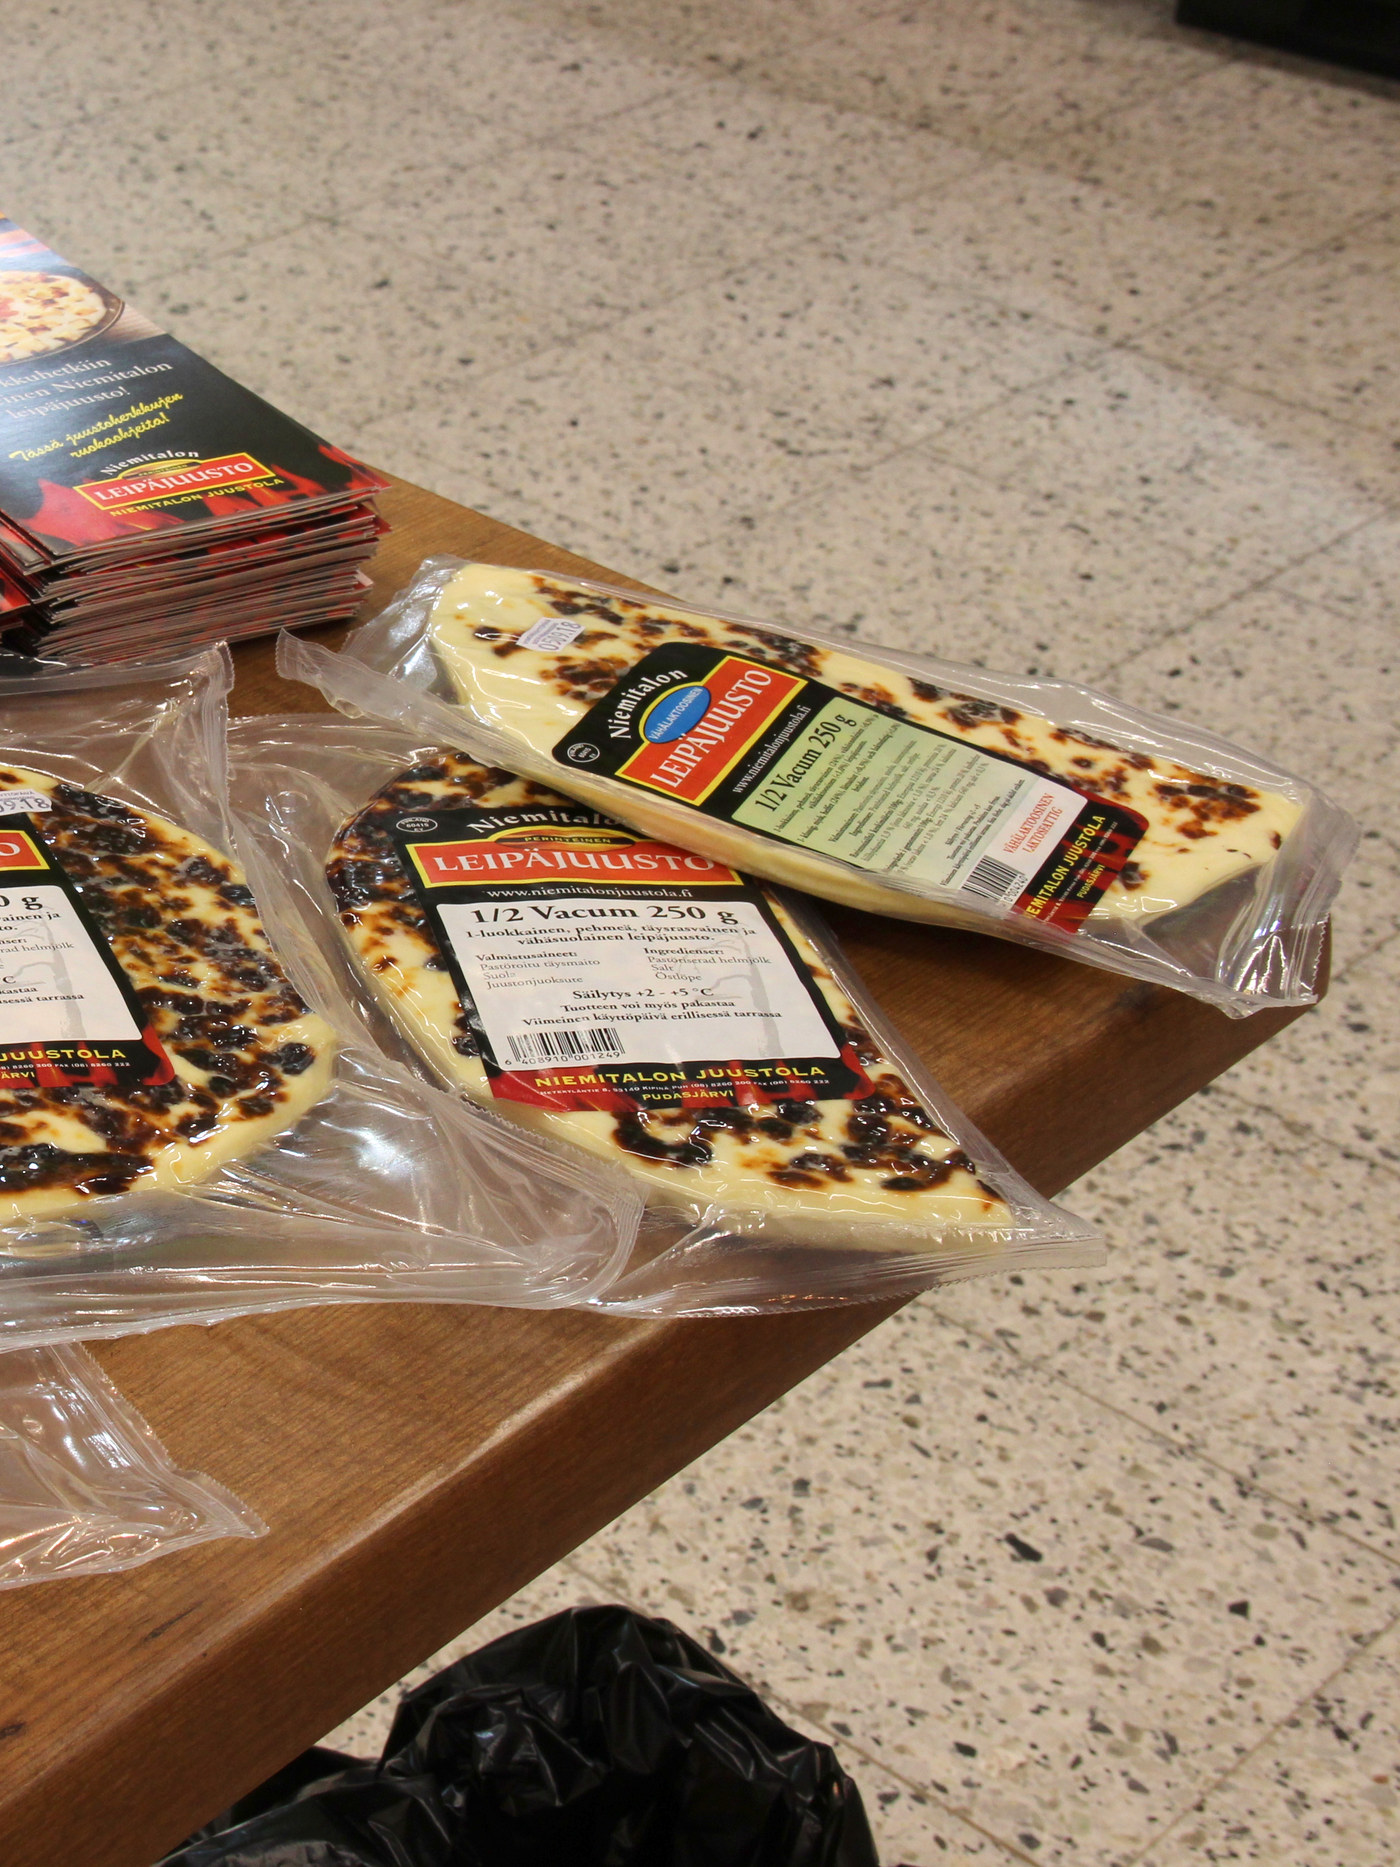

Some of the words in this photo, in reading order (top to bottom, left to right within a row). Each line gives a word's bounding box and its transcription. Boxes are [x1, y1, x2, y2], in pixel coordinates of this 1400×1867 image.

[51, 361, 173, 394] Niemitalon
[5, 386, 130, 420] leipäjuusto!
[8, 439, 64, 462] Tässä
[66, 392, 184, 446] juustoherkkujen
[70, 412, 170, 459] ruokaohjeita!
[100, 449, 200, 476] Niemitalon
[94, 461, 254, 501] LEIPÄJUUSTO
[109, 493, 203, 517] NIEMITALON
[206, 479, 285, 498] JUUSTOLA
[608, 668, 688, 741] Niemitalon
[650, 669, 772, 788] LEIPÄJUUSTO
[732, 705, 812, 794] www.niemitalonjuustola.fi
[755, 789, 787, 812] 1/2
[771, 748, 822, 789] Vacum
[808, 721, 842, 749] 250
[834, 714, 857, 727] g
[466, 810, 616, 834] Niemitalo
[524, 836, 611, 844] PERINTEINEN
[1063, 814, 1106, 866] JUUSTOLA
[433, 848, 715, 871] LEIPÄJUUSTO
[486, 885, 693, 898] www.niemitalonjuustola.fi
[21, 896, 43, 910] g
[45, 912, 62, 921] ja
[470, 908, 524, 923] 1/2
[528, 906, 640, 920] Vacum
[646, 905, 706, 920] 250
[717, 910, 739, 925] g
[466, 928, 571, 938] 1-luokkainen,
[575, 924, 637, 936] pehmeä,
[641, 924, 739, 934] täysrasvainen
[742, 927, 757, 936] ja
[517, 933, 624, 945] vähäsuolainen
[628, 932, 715, 942] leipäjuusto.
[475, 951, 578, 962] Valmistusaineet:
[643, 947, 724, 955] Ingredienser:
[479, 961, 540, 971] Pastöroitu
[543, 958, 600, 969] täysmaito
[486, 976, 584, 990] Juustonjuoksute
[36, 993, 85, 1001] tarrassa
[572, 989, 631, 1000] Säilytys
[636, 988, 655, 997] +2
[671, 988, 689, 996] +5
[560, 1003, 617, 1013] Tuotteen
[621, 1001, 641, 1009] voi
[644, 1001, 677, 1010] myös
[681, 1000, 735, 1009] pakastaa
[522, 1015, 590, 1026] Viimeinen
[593, 1012, 667, 1023] käyttöpäivä
[670, 1010, 730, 1020] erillisessä
[734, 1010, 782, 1018] tarrassa
[521, 1054, 568, 1065] 408910
[574, 1051, 620, 1061] 001249
[534, 1071, 687, 1087] NIEMITALON
[696, 1066, 825, 1079] JUUSTOLA
[642, 1089, 734, 1101] PUDASJÄRVI
